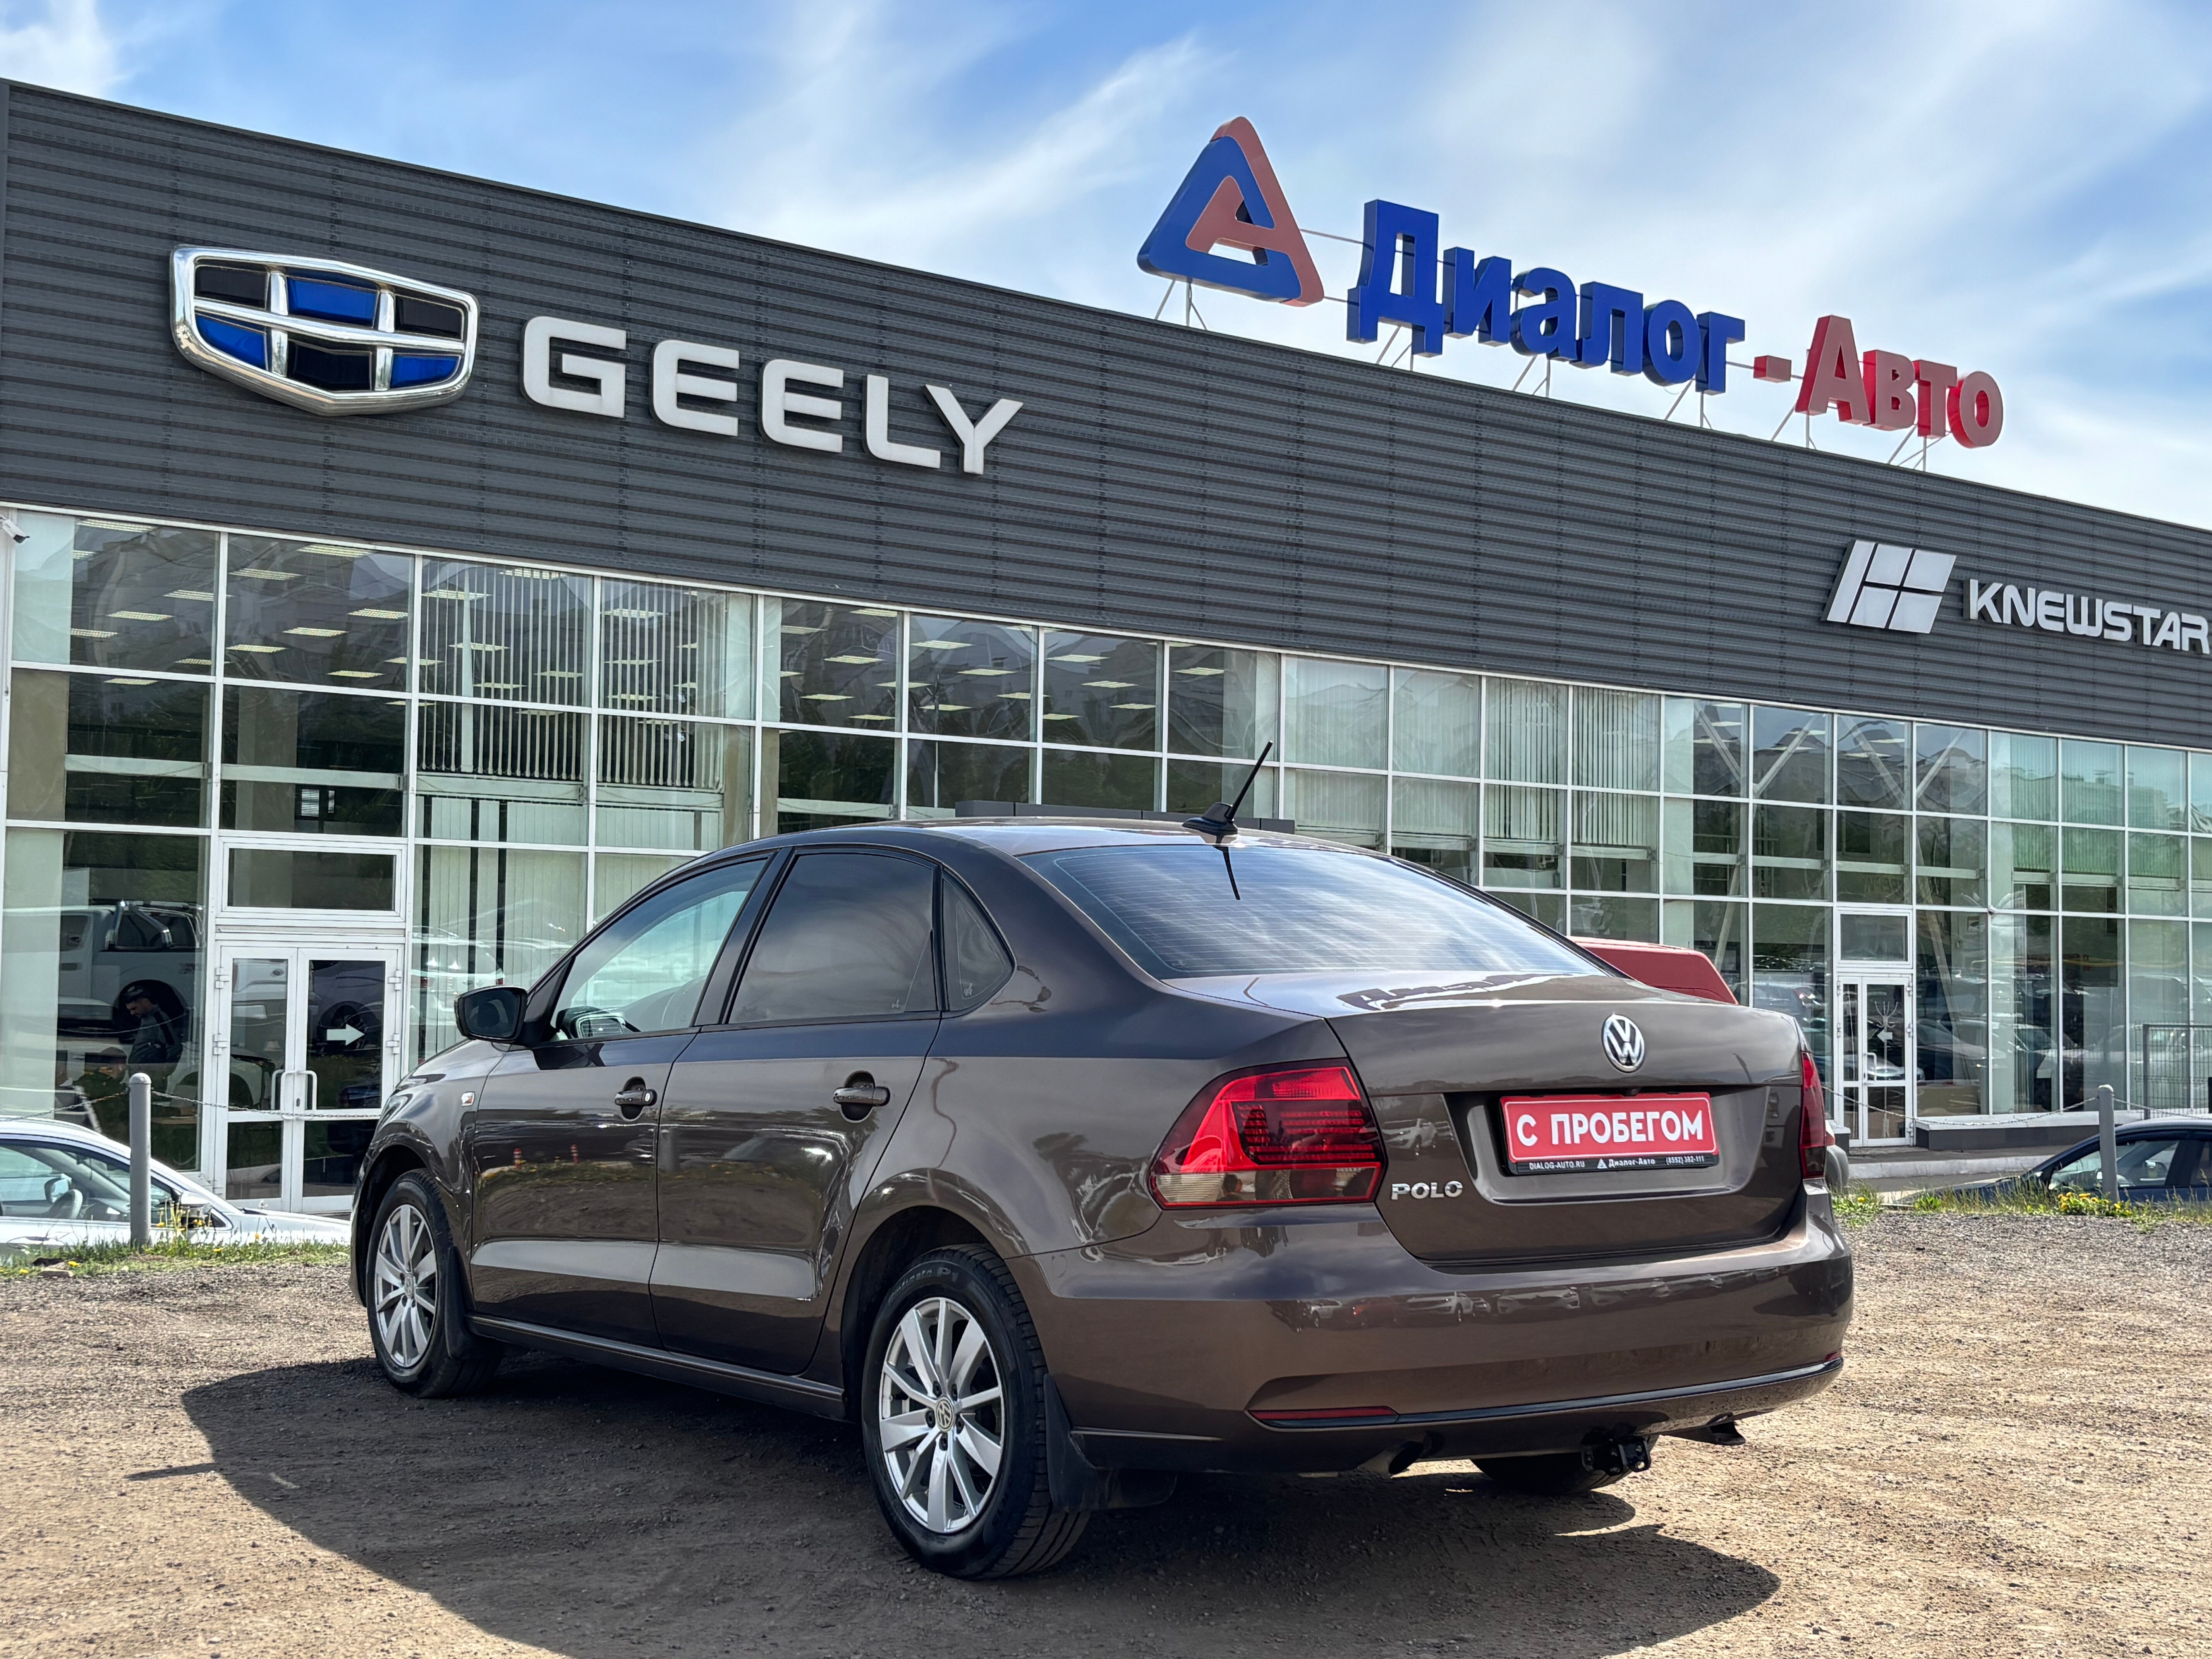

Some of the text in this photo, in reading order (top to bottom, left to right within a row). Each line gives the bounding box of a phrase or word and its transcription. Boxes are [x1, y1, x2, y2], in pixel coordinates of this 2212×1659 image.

[522, 315, 1024, 475] GEELY
[1968, 579, 2210, 654] KNEWSTAR
[1517, 1110, 1703, 1146] С ПРОБЕГОМ
[1529, 1161, 1585, 1170] DIALOG-AUTO.RU
[1391, 1180, 1463, 1200] POLO
